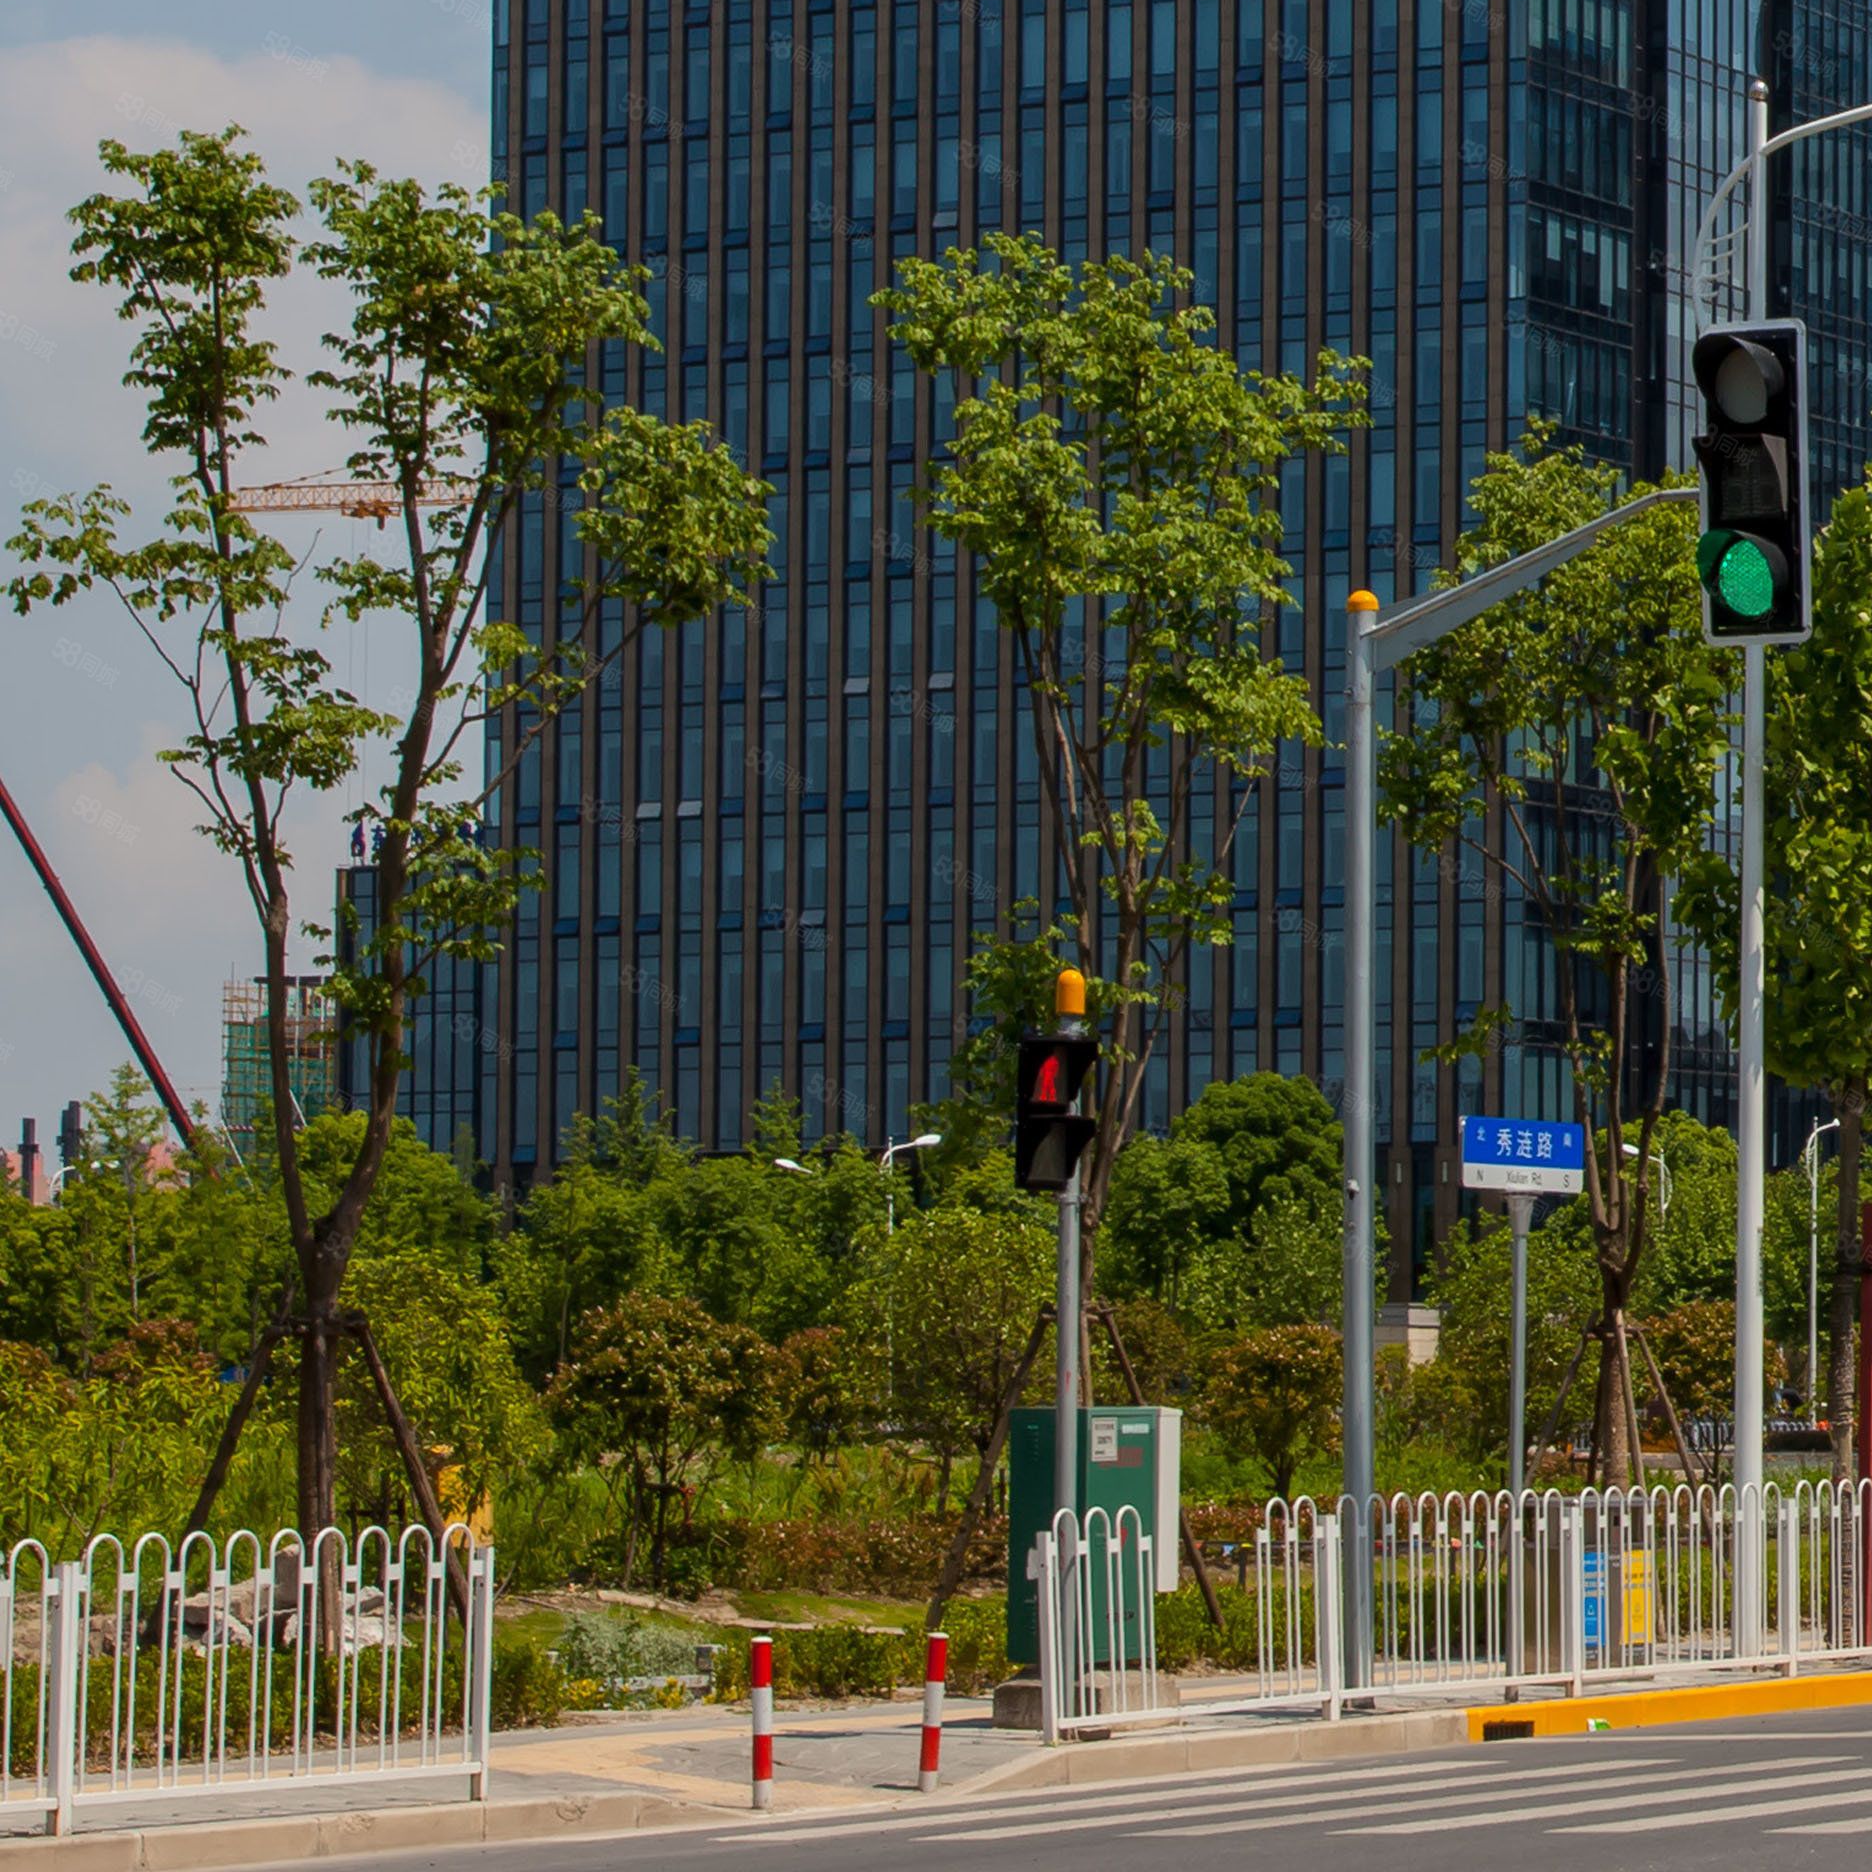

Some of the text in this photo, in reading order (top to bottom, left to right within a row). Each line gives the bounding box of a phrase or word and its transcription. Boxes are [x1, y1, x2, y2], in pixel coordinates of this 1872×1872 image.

[1497, 1128, 1552, 1159] 秀涟路
[1477, 1169, 1484, 1181] N
[1562, 1174, 1571, 1189] S
